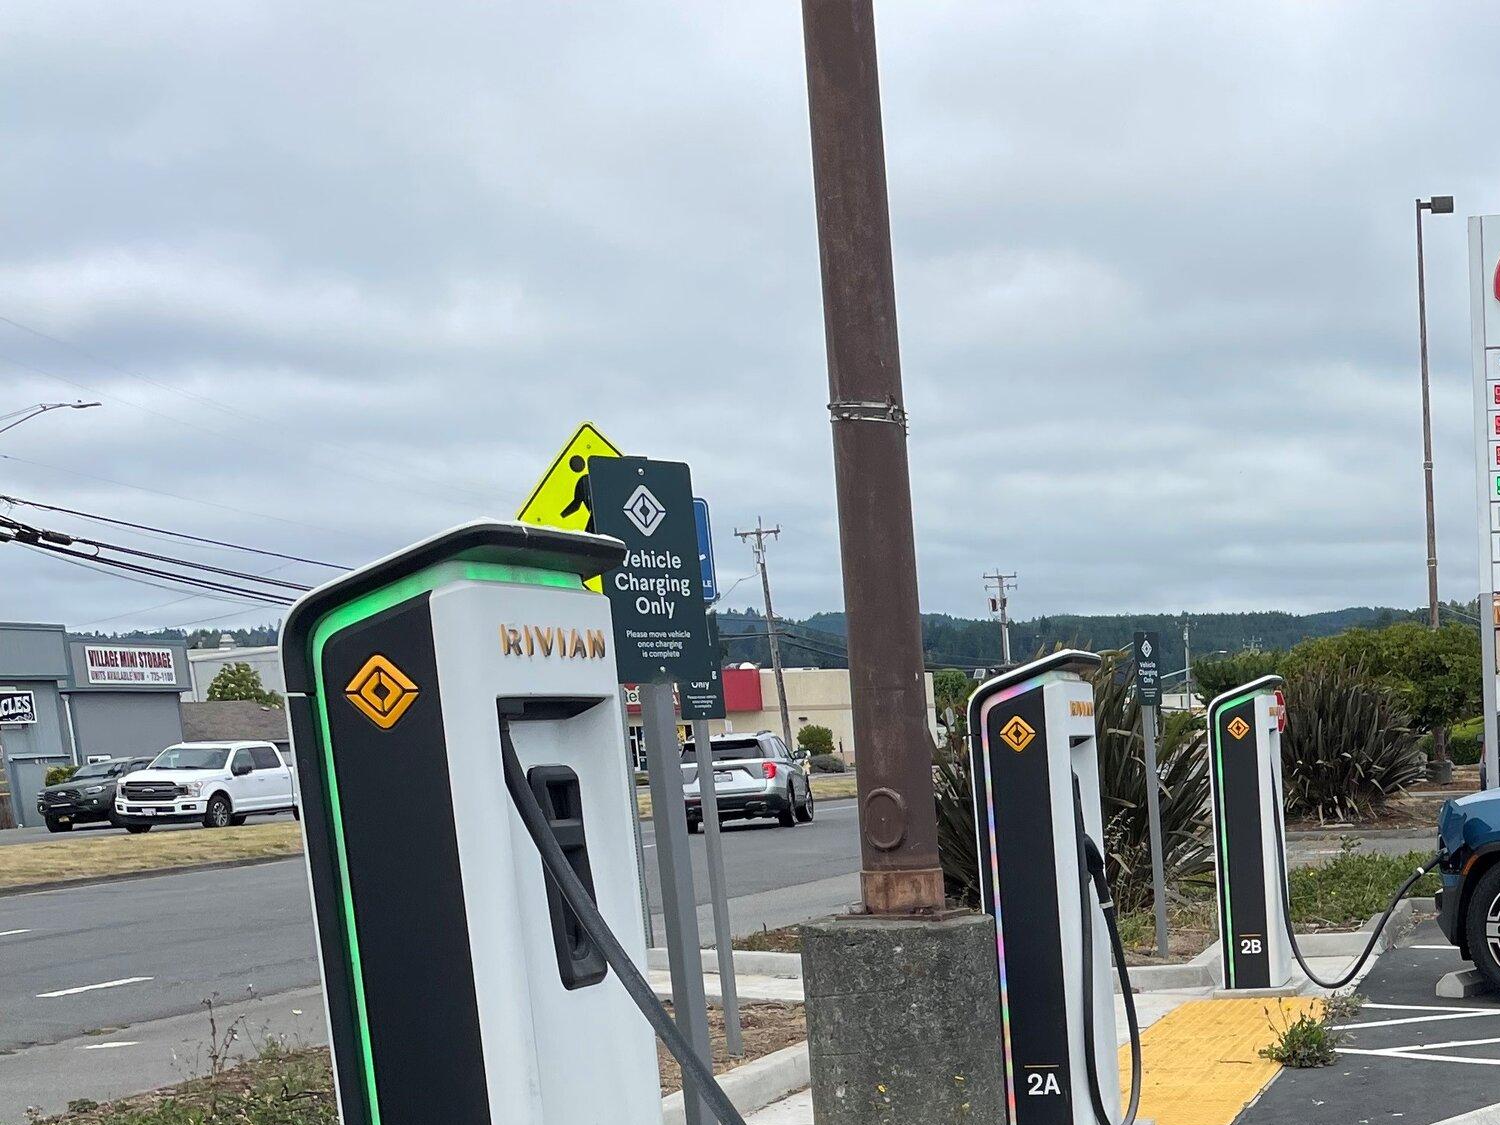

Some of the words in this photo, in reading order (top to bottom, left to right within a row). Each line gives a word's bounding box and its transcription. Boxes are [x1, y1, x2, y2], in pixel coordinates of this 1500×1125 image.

[623, 550, 681, 569] Vehicle
[615, 573, 691, 597] Charging
[635, 596, 675, 619] Only
[500, 623, 606, 659] RIVIAN
[626, 629, 648, 638] Please
[668, 630, 691, 638] vehicle
[655, 640, 683, 650] charging
[88, 650, 119, 667] VILLAGE
[119, 651, 138, 668] MINI
[138, 651, 172, 668] STORAGE
[642, 650, 648, 658] is
[649, 650, 680, 659] complete
[91, 670, 106, 680] UNITS
[107, 671, 133, 681] AVAILABLE
[133, 672, 145, 681] NOW
[0, 696, 31, 716] CLES
[1240, 939, 1262, 955] 2B
[1027, 1073, 1061, 1096] 2A
